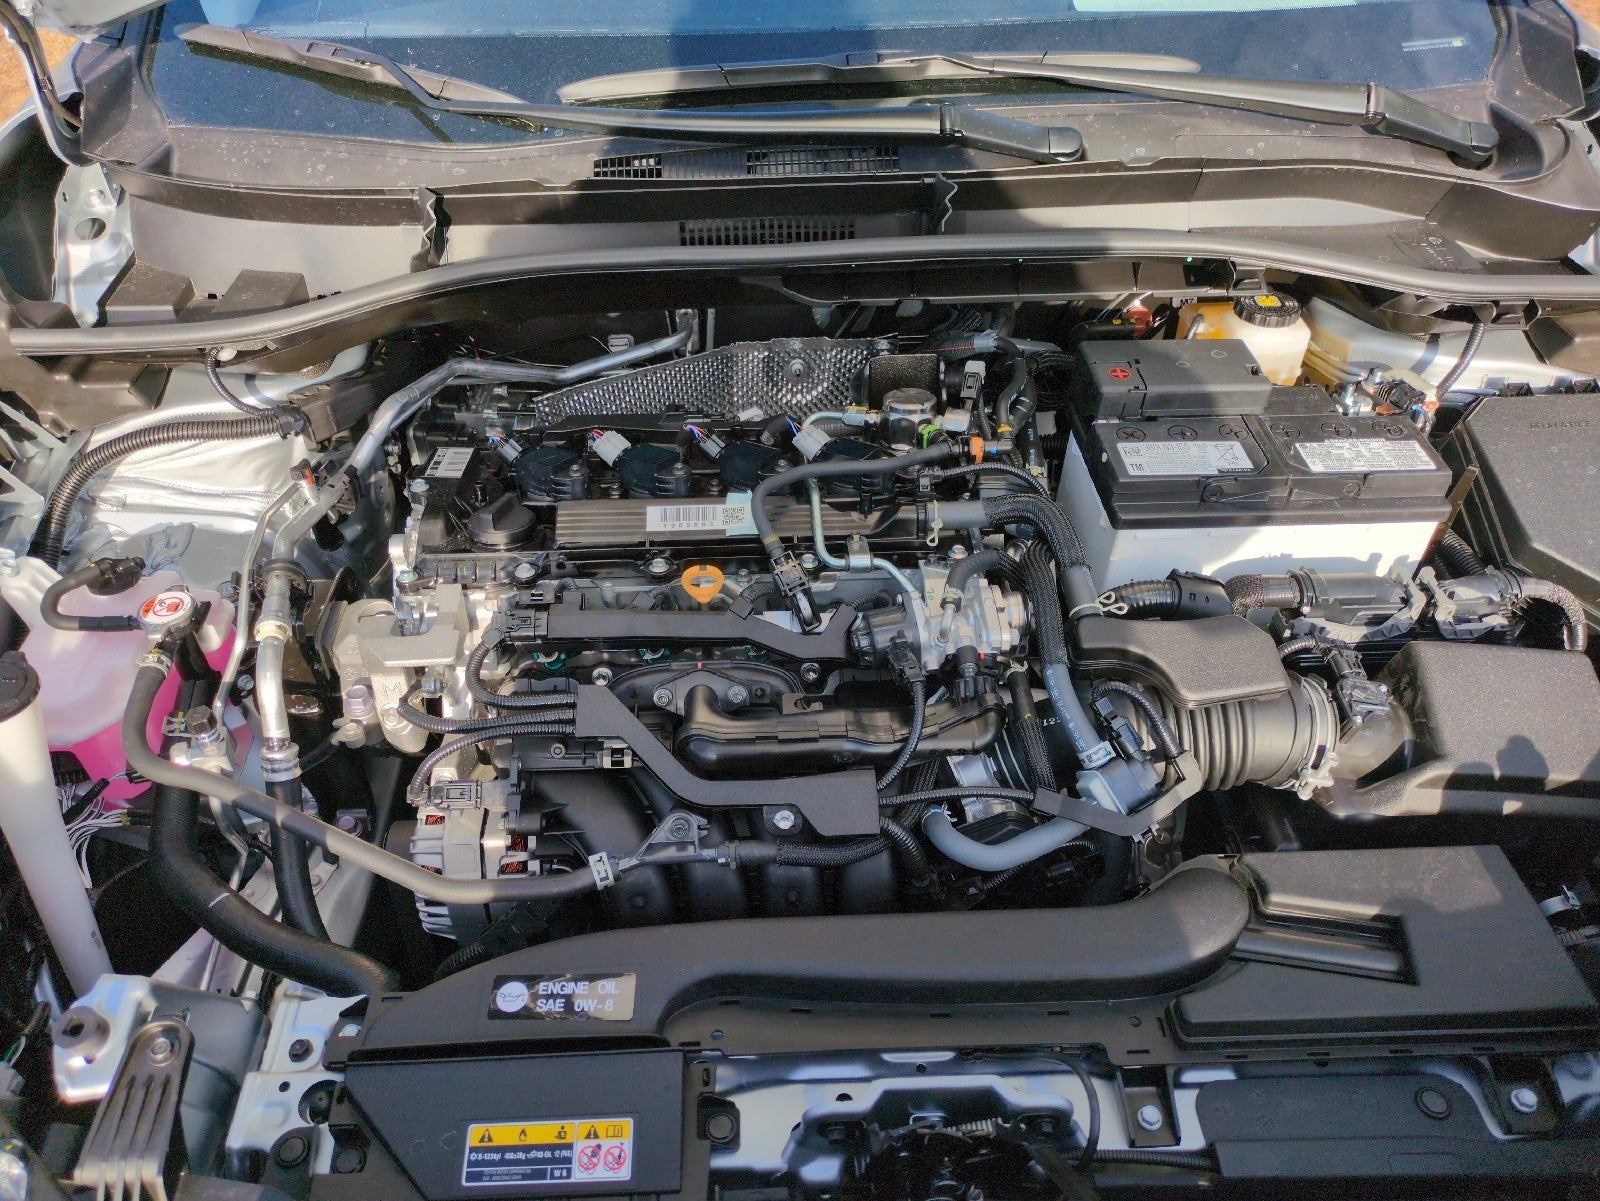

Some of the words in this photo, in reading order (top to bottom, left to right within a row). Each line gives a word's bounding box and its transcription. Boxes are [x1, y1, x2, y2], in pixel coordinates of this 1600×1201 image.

[538, 981, 590, 995] ENGINE
[597, 981, 620, 994] OIL
[536, 998, 566, 1012] SAE
[574, 998, 614, 1012] 0W-8
[553, 1169, 562, 1178] W
